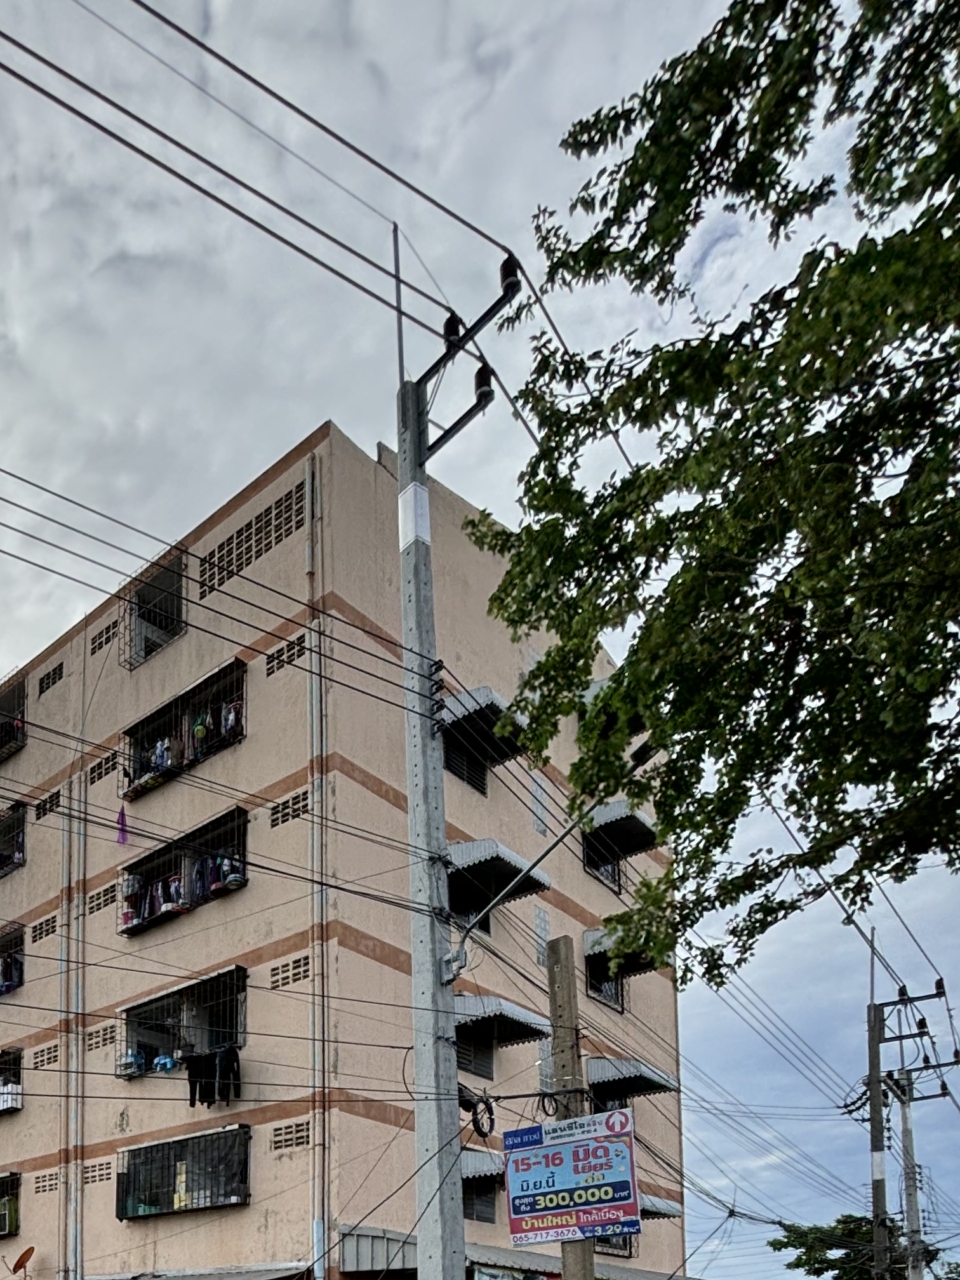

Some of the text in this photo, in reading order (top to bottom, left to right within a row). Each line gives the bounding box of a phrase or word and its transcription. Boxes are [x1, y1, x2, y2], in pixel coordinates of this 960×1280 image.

[512, 1151, 564, 1174] 15-16
[572, 1143, 610, 1164] มิด
[520, 1171, 556, 1193] มิ.ย.นี้
[535, 1186, 614, 1210] 300,000
[521, 1209, 624, 1230] บ้านใหญ่ ใกล้เมือง
[594, 1224, 623, 1236] 3.29
[512, 1228, 578, 1244] 065-717-3676
